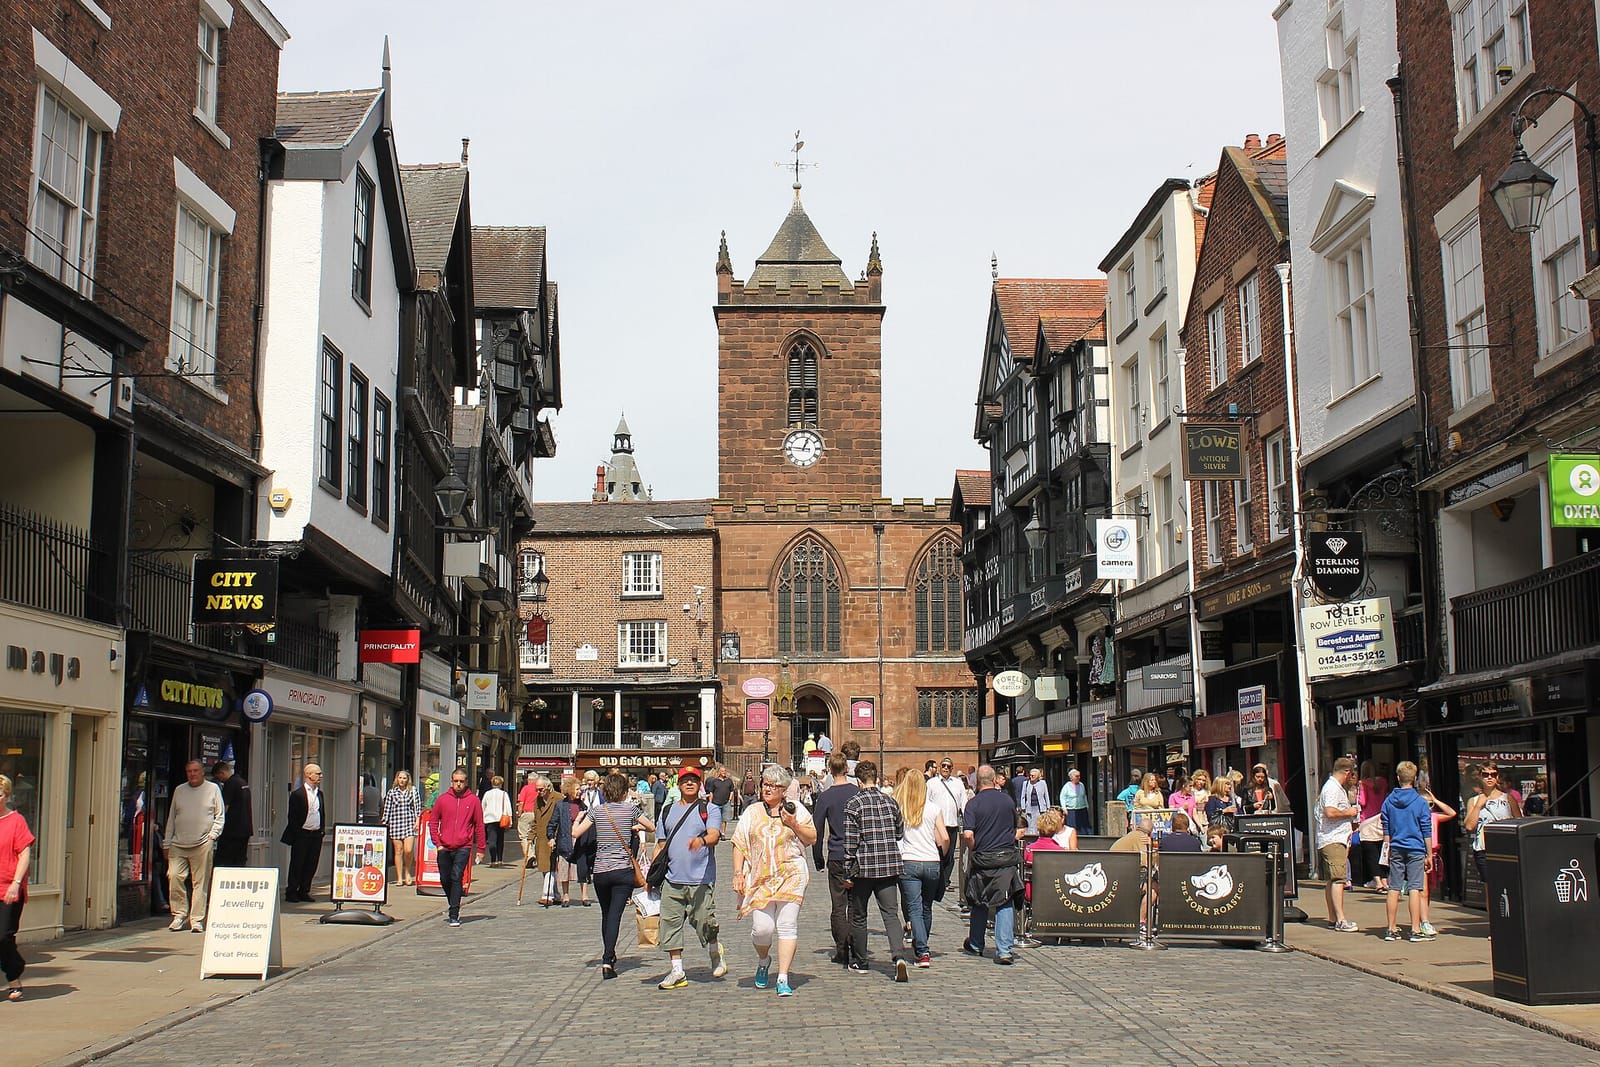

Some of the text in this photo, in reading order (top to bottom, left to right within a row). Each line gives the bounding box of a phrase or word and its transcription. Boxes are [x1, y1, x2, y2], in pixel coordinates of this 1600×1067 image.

[122, 383, 131, 401] 18
[1189, 435, 1238, 449] LOWE
[1564, 504, 1600, 518] OXFA
[211, 572, 257, 587] CITY
[1226, 591, 1240, 605] LOWE
[1247, 583, 1262, 597] SONS
[205, 595, 264, 610] NEWS
[1347, 606, 1366, 616] LET
[1311, 614, 1385, 630] ROW LEVEL SHOP
[1318, 633, 1380, 646] Beresford Adams
[1318, 650, 1385, 665] 01244-351212
[7, 645, 80, 687] maya
[162, 679, 190, 704] CITY
[190, 684, 223, 709] NEWS
[288, 689, 327, 706] PRINCIPALITY
[1472, 688, 1493, 705] YORK
[1127, 717, 1161, 740] SWAROVSKI
[600, 756, 667, 766] OLD GUYS RULE
[359, 871, 381, 880] 2 for
[219, 880, 269, 893] maya
[362, 881, 377, 891] £2
[1054, 878, 1062, 894] THE
[1060, 893, 1083, 913] YORK
[1087, 891, 1116, 914] ROAST
[1180, 880, 1189, 896] THE
[1185, 896, 1210, 915] YORK
[1213, 893, 1241, 915] ROAST
[220, 899, 264, 909] Jewellery
[242, 922, 268, 930] Designs
[214, 932, 230, 940] Huge
